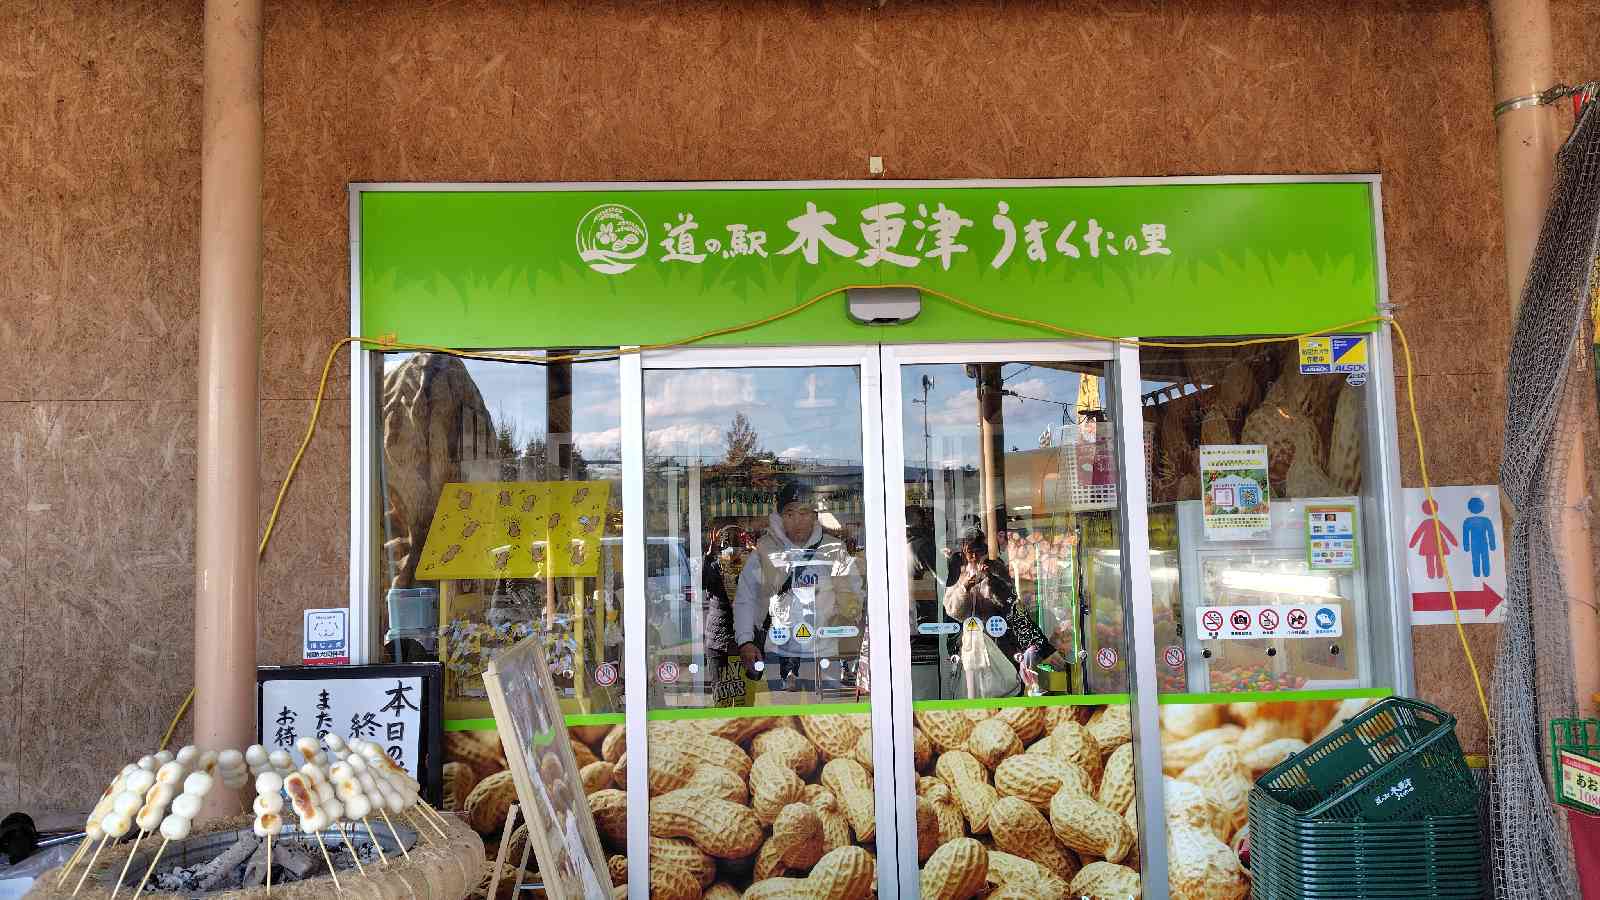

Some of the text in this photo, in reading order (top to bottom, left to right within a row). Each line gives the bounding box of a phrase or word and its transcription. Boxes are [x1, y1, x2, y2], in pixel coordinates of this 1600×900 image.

[660, 201, 1172, 271] 道の駅 木更津 うまくたの里
[274, 705, 298, 751] お待
[315, 688, 333, 752] またの
[380, 680, 420, 772] 本日の
